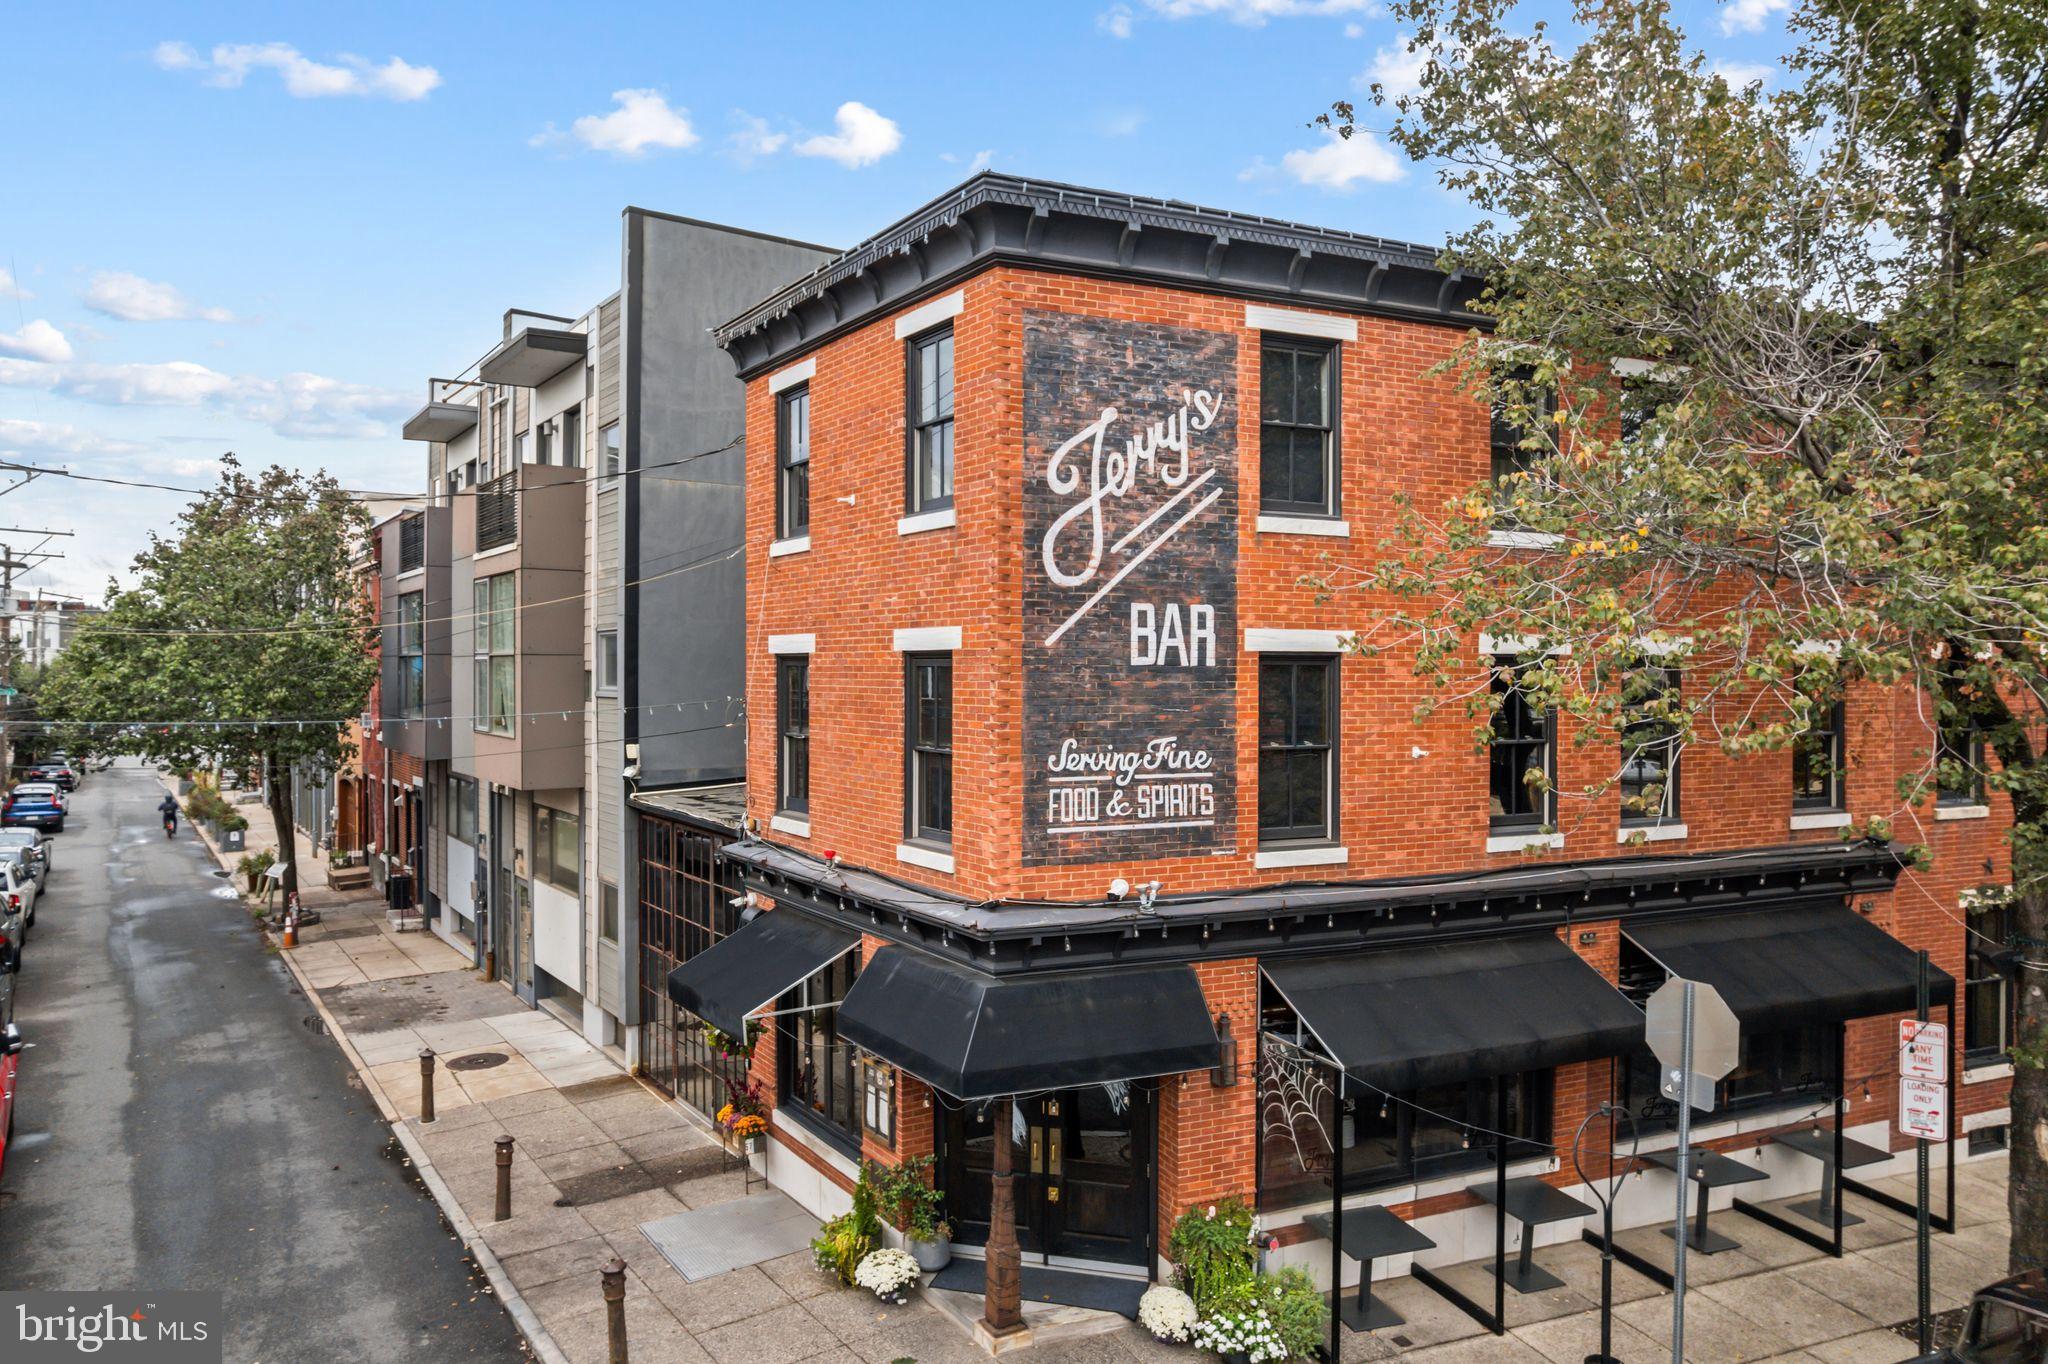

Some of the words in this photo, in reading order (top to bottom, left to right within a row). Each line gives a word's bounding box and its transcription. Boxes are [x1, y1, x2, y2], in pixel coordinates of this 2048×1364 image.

[1043, 389, 1223, 587] Jerry's
[1131, 602, 1216, 667] BAR
[1048, 738, 1142, 787] Serving
[1142, 736, 1213, 769] Fine
[1049, 787, 1099, 823] FOOD
[1106, 789, 1133, 817] &
[1138, 783, 1215, 819] SPIRITS
[1902, 1025, 1914, 1037] NO
[1914, 1045, 1932, 1054] ANY
[1913, 1054, 1934, 1065] TIME
[1907, 1082, 1939, 1094] LOADING
[1913, 1095, 1932, 1104] ONLY
